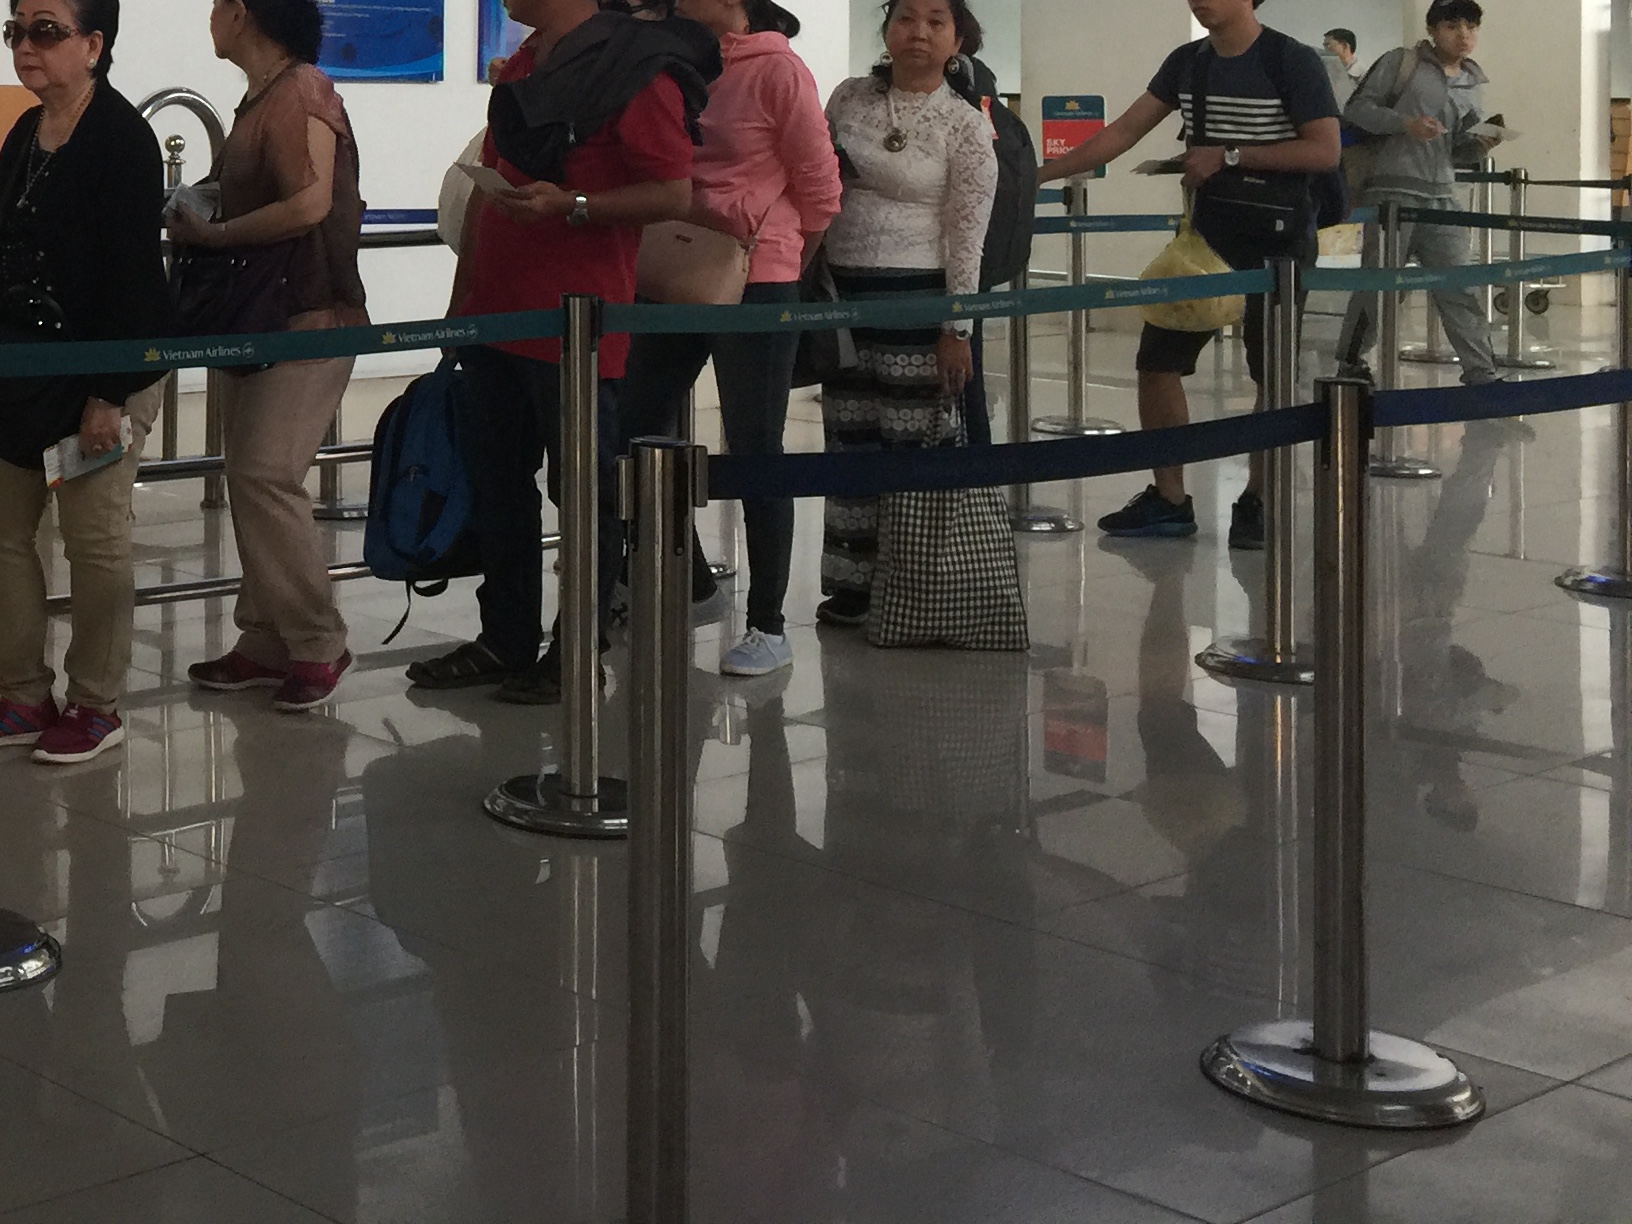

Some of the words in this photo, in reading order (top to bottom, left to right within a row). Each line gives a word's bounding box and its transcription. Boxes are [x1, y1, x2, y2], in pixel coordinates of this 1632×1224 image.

[1046, 138, 1066, 147] SKY
[1046, 146, 1075, 155] PRIO
[162, 349, 204, 361] Vietnam
[205, 345, 241, 357] Airlines
